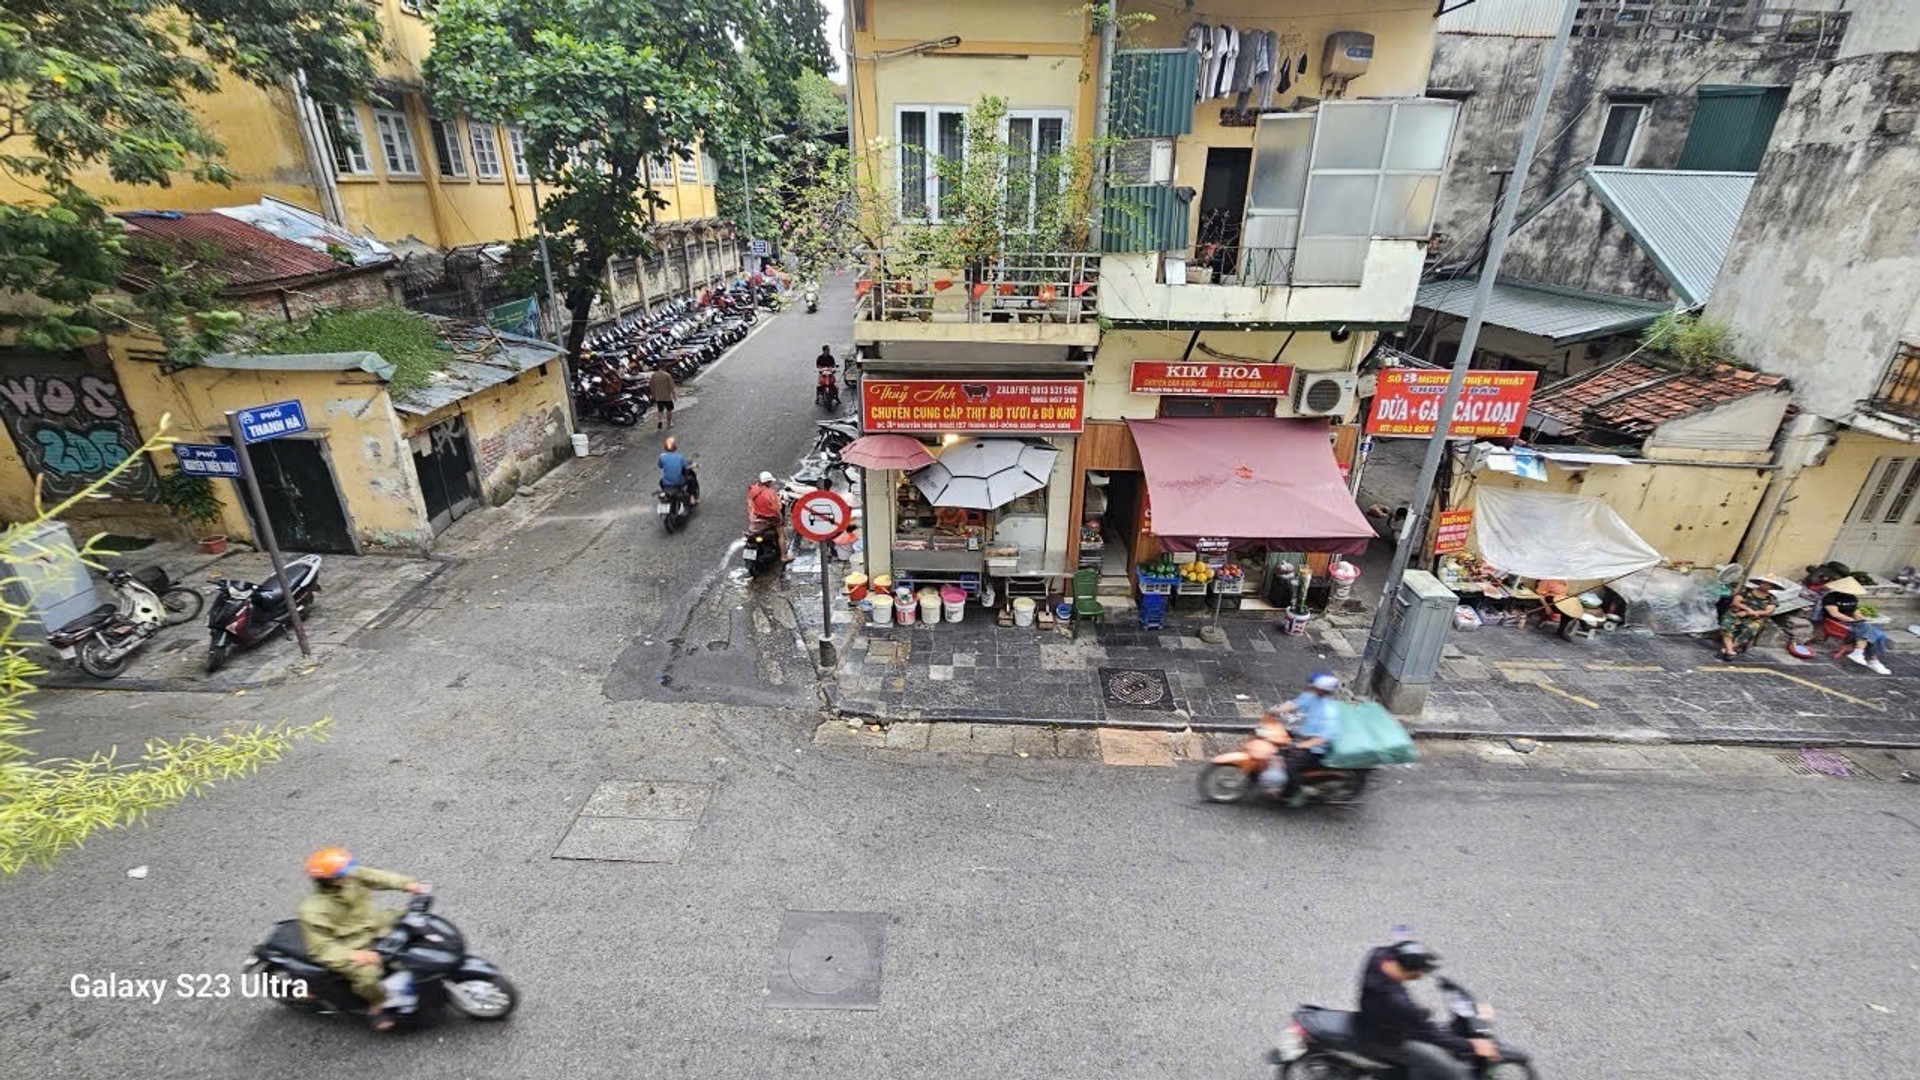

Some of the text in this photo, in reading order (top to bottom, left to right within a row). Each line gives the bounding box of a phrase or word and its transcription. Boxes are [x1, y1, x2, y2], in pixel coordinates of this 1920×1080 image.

[1165, 366, 1262, 379] KIM HOA
[1403, 372, 1418, 384] 3
[913, 384, 957, 402] Anh
[913, 406, 941, 419] CUNG
[966, 406, 987, 421] THỊT
[1032, 409, 1040, 419] &
[1452, 395, 1483, 422] CÁC
[247, 414, 301, 438] THANH HÀ
